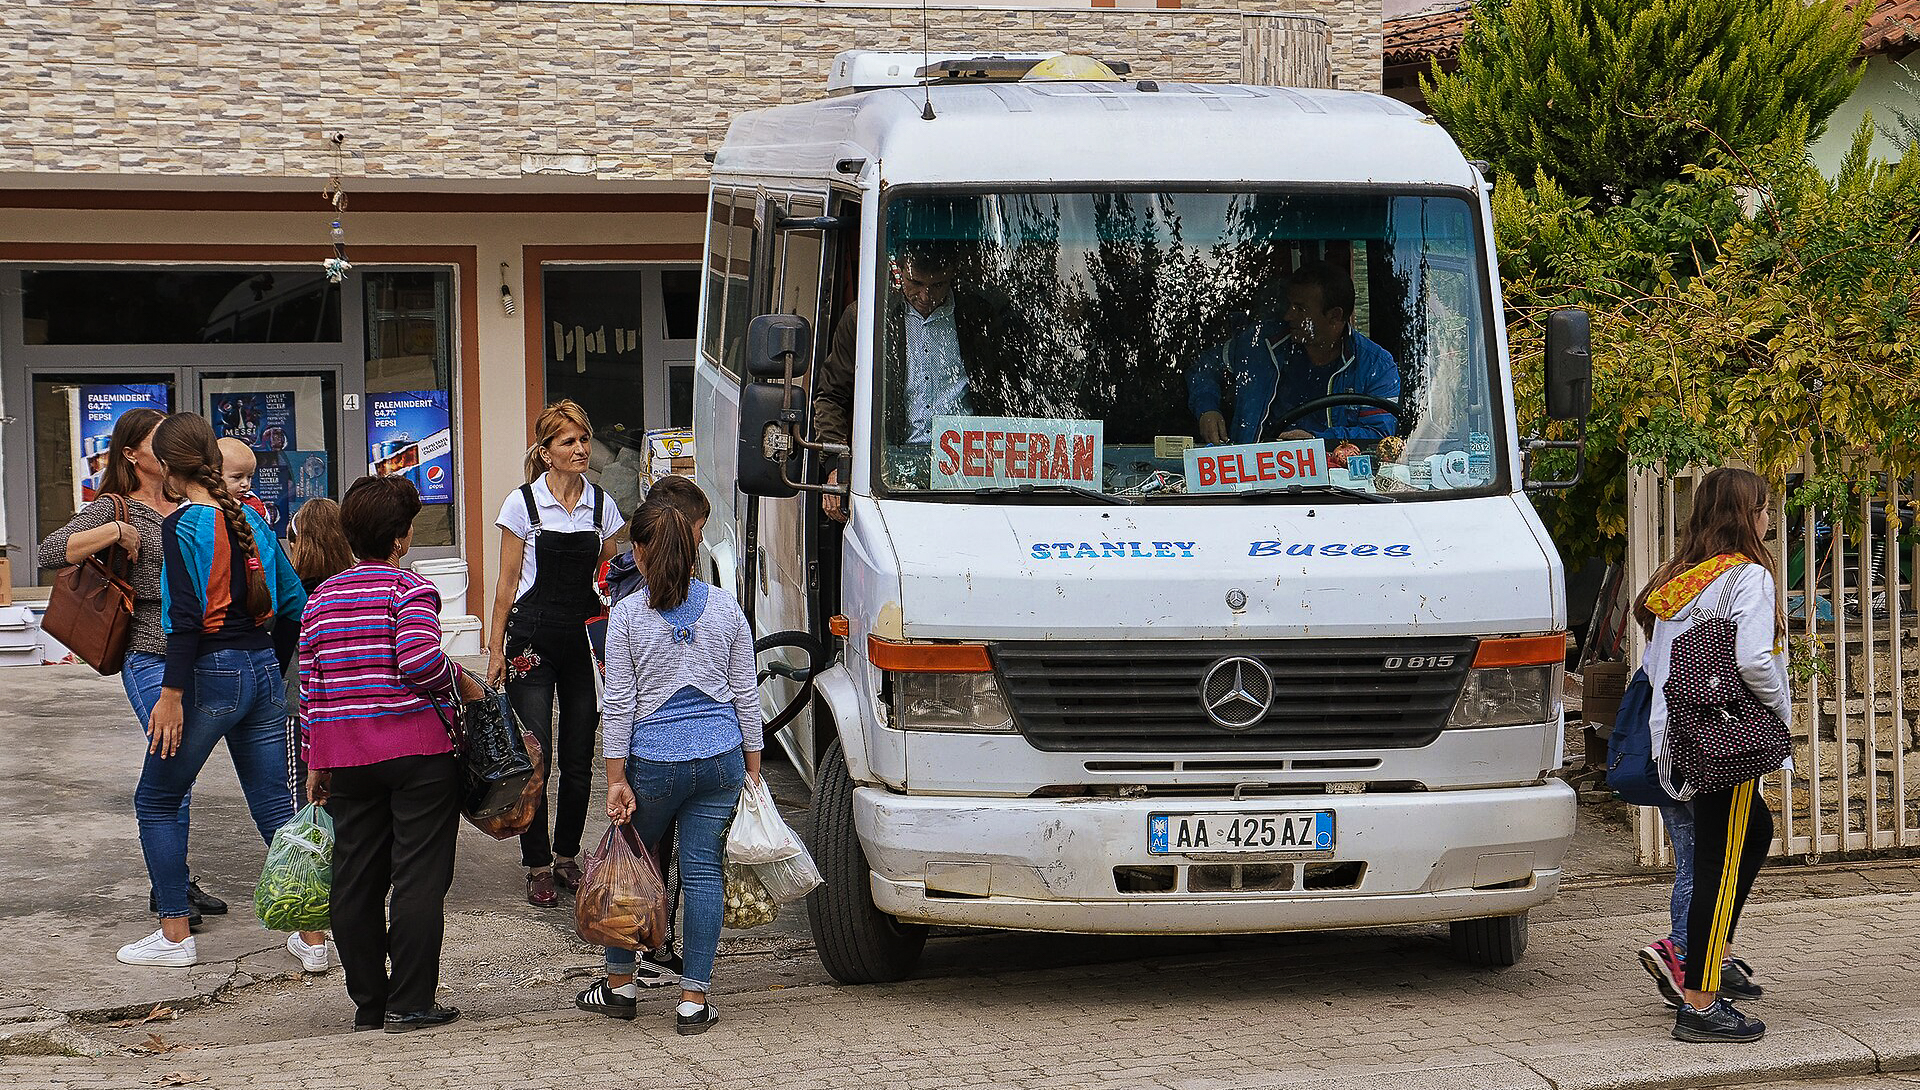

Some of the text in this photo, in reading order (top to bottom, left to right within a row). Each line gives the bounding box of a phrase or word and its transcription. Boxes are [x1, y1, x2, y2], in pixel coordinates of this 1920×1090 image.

[346, 395, 356, 408] 4
[374, 400, 432, 409] FALEMINDERIT
[938, 430, 1094, 482] SEFERAN
[1198, 449, 1316, 486] BELESH
[1350, 458, 1368, 477] 16
[1031, 541, 1412, 559] STANLEY Buses
[1407, 656, 1455, 668] 815
[1177, 818, 1313, 847] AA 425 AZ
